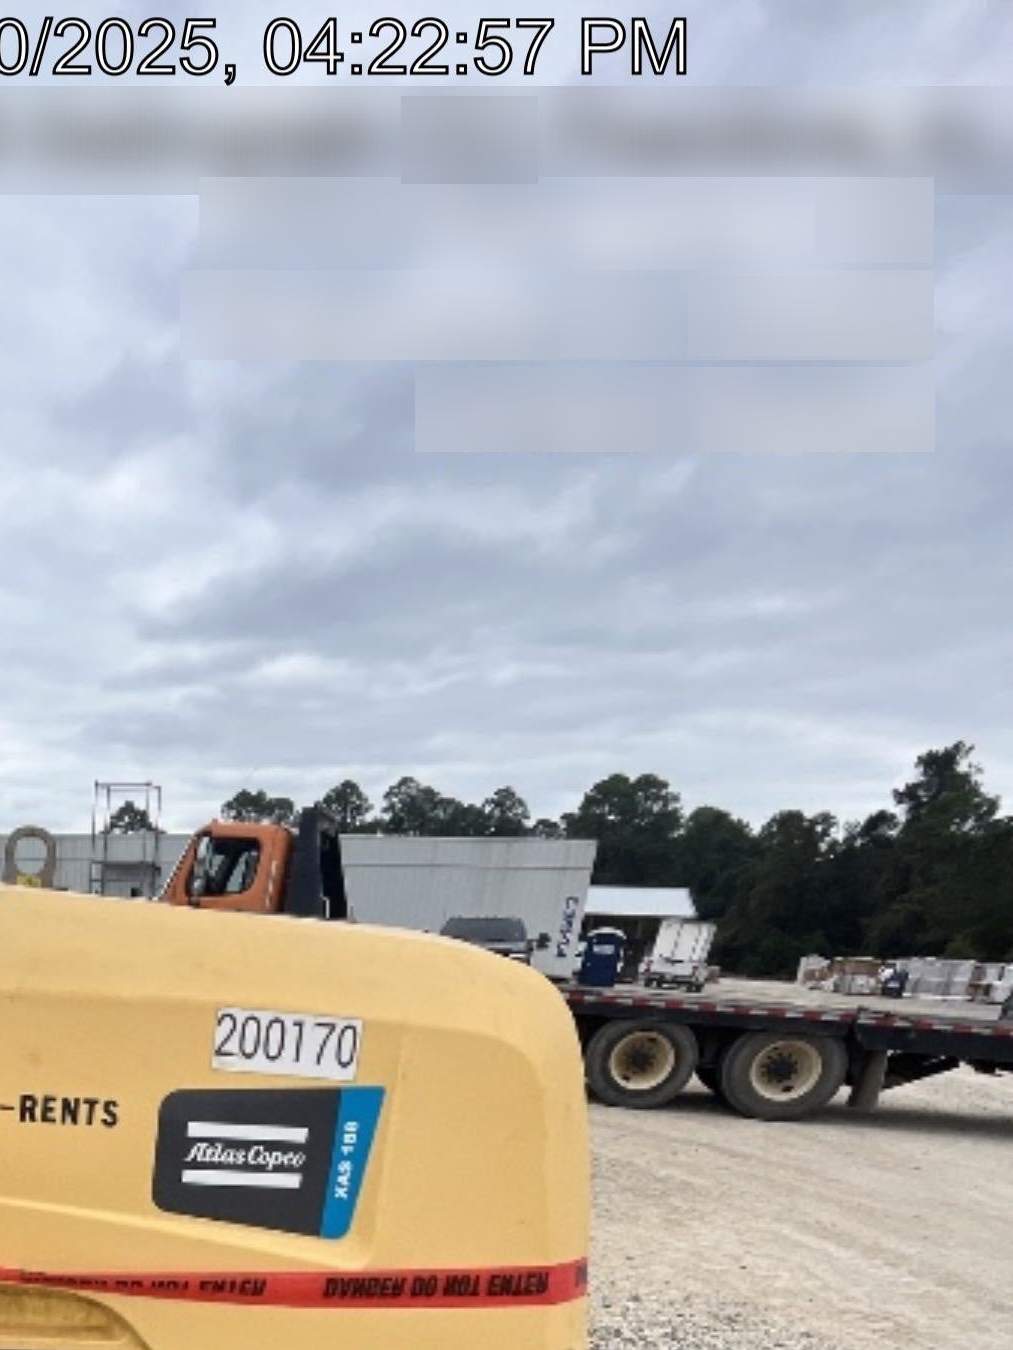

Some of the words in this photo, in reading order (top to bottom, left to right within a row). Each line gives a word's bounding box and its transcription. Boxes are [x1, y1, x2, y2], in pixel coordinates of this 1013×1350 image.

[214, 1012, 359, 1069] 200170
[184, 1142, 247, 1165] Atlas
[248, 1145, 306, 1171] Copco
[334, 1160, 352, 1199] XAS
